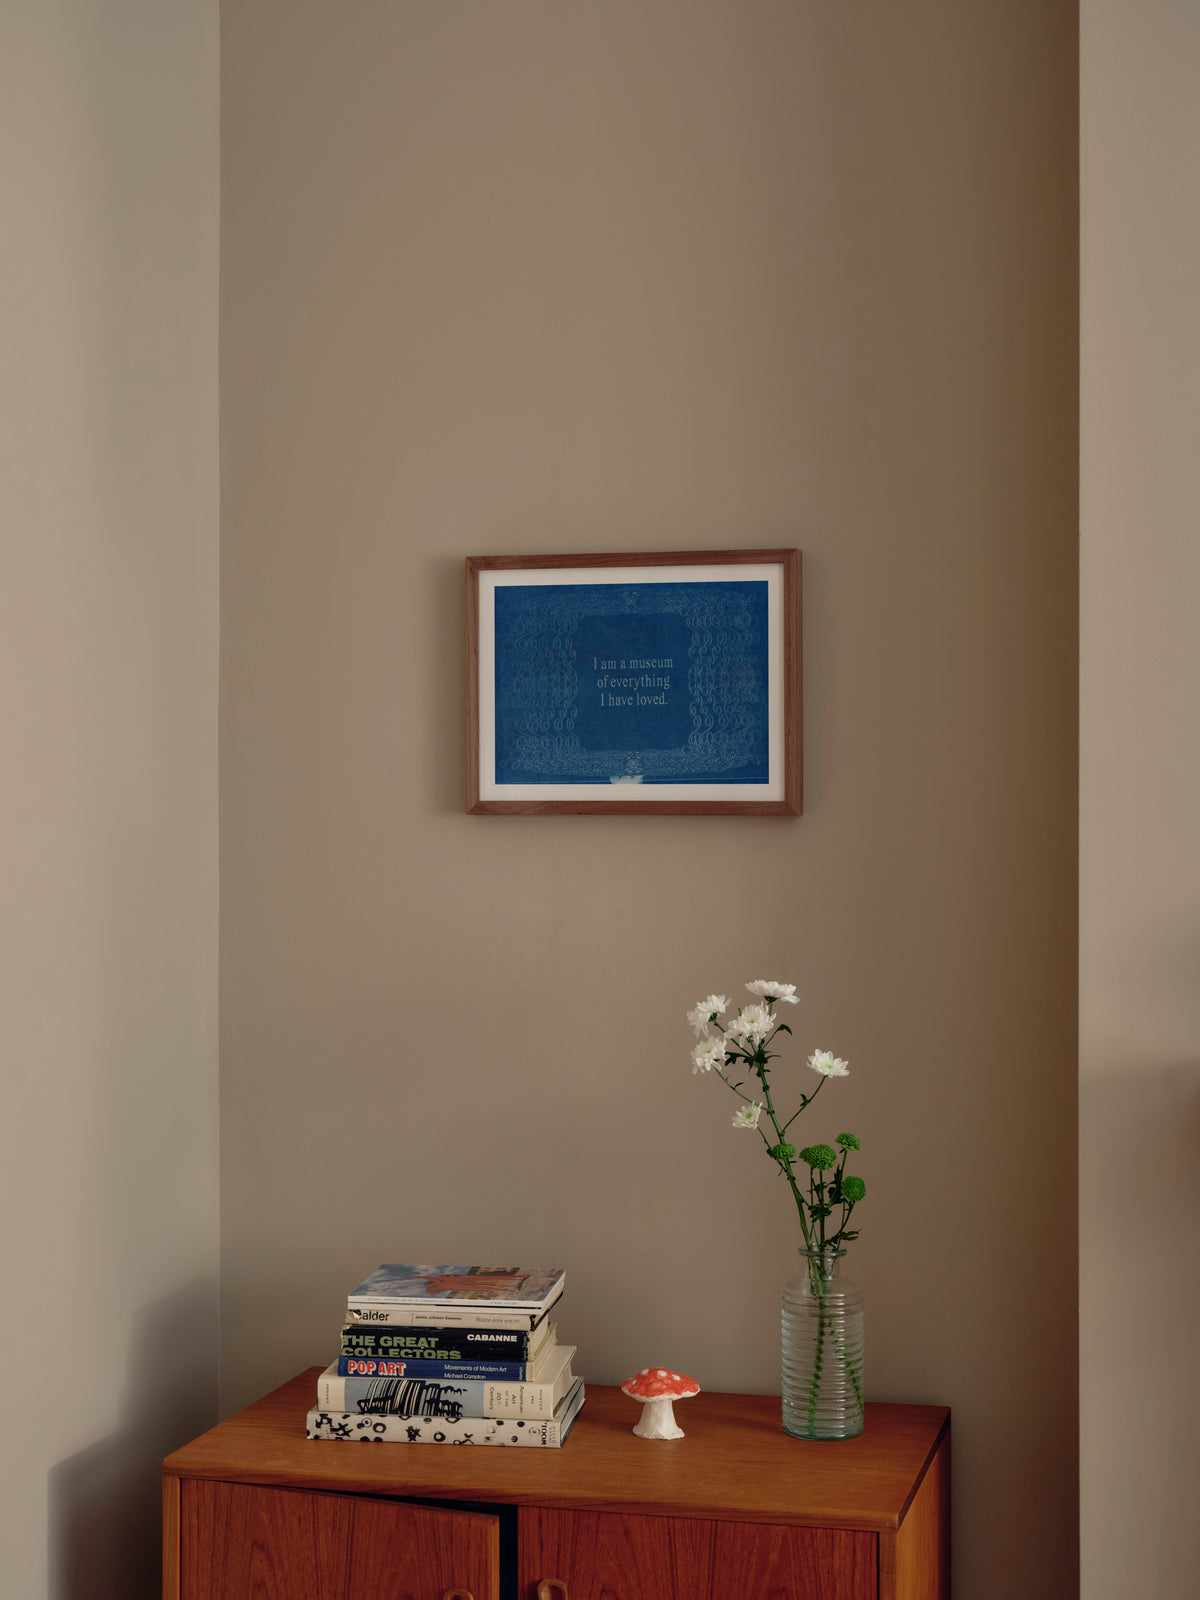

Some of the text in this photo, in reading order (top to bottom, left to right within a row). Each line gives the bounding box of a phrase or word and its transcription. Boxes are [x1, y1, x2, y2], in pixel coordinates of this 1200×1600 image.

[593, 656, 673, 670] I am a museum
[596, 673, 671, 691] of everything
[600, 692, 669, 707] I have loved.
[353, 1310, 390, 1321] alder
[342, 1335, 440, 1348] THE GREAT
[466, 1333, 518, 1343] CABANNE
[341, 1346, 462, 1360] COLLECTORS
[348, 1360, 407, 1377] POP ART
